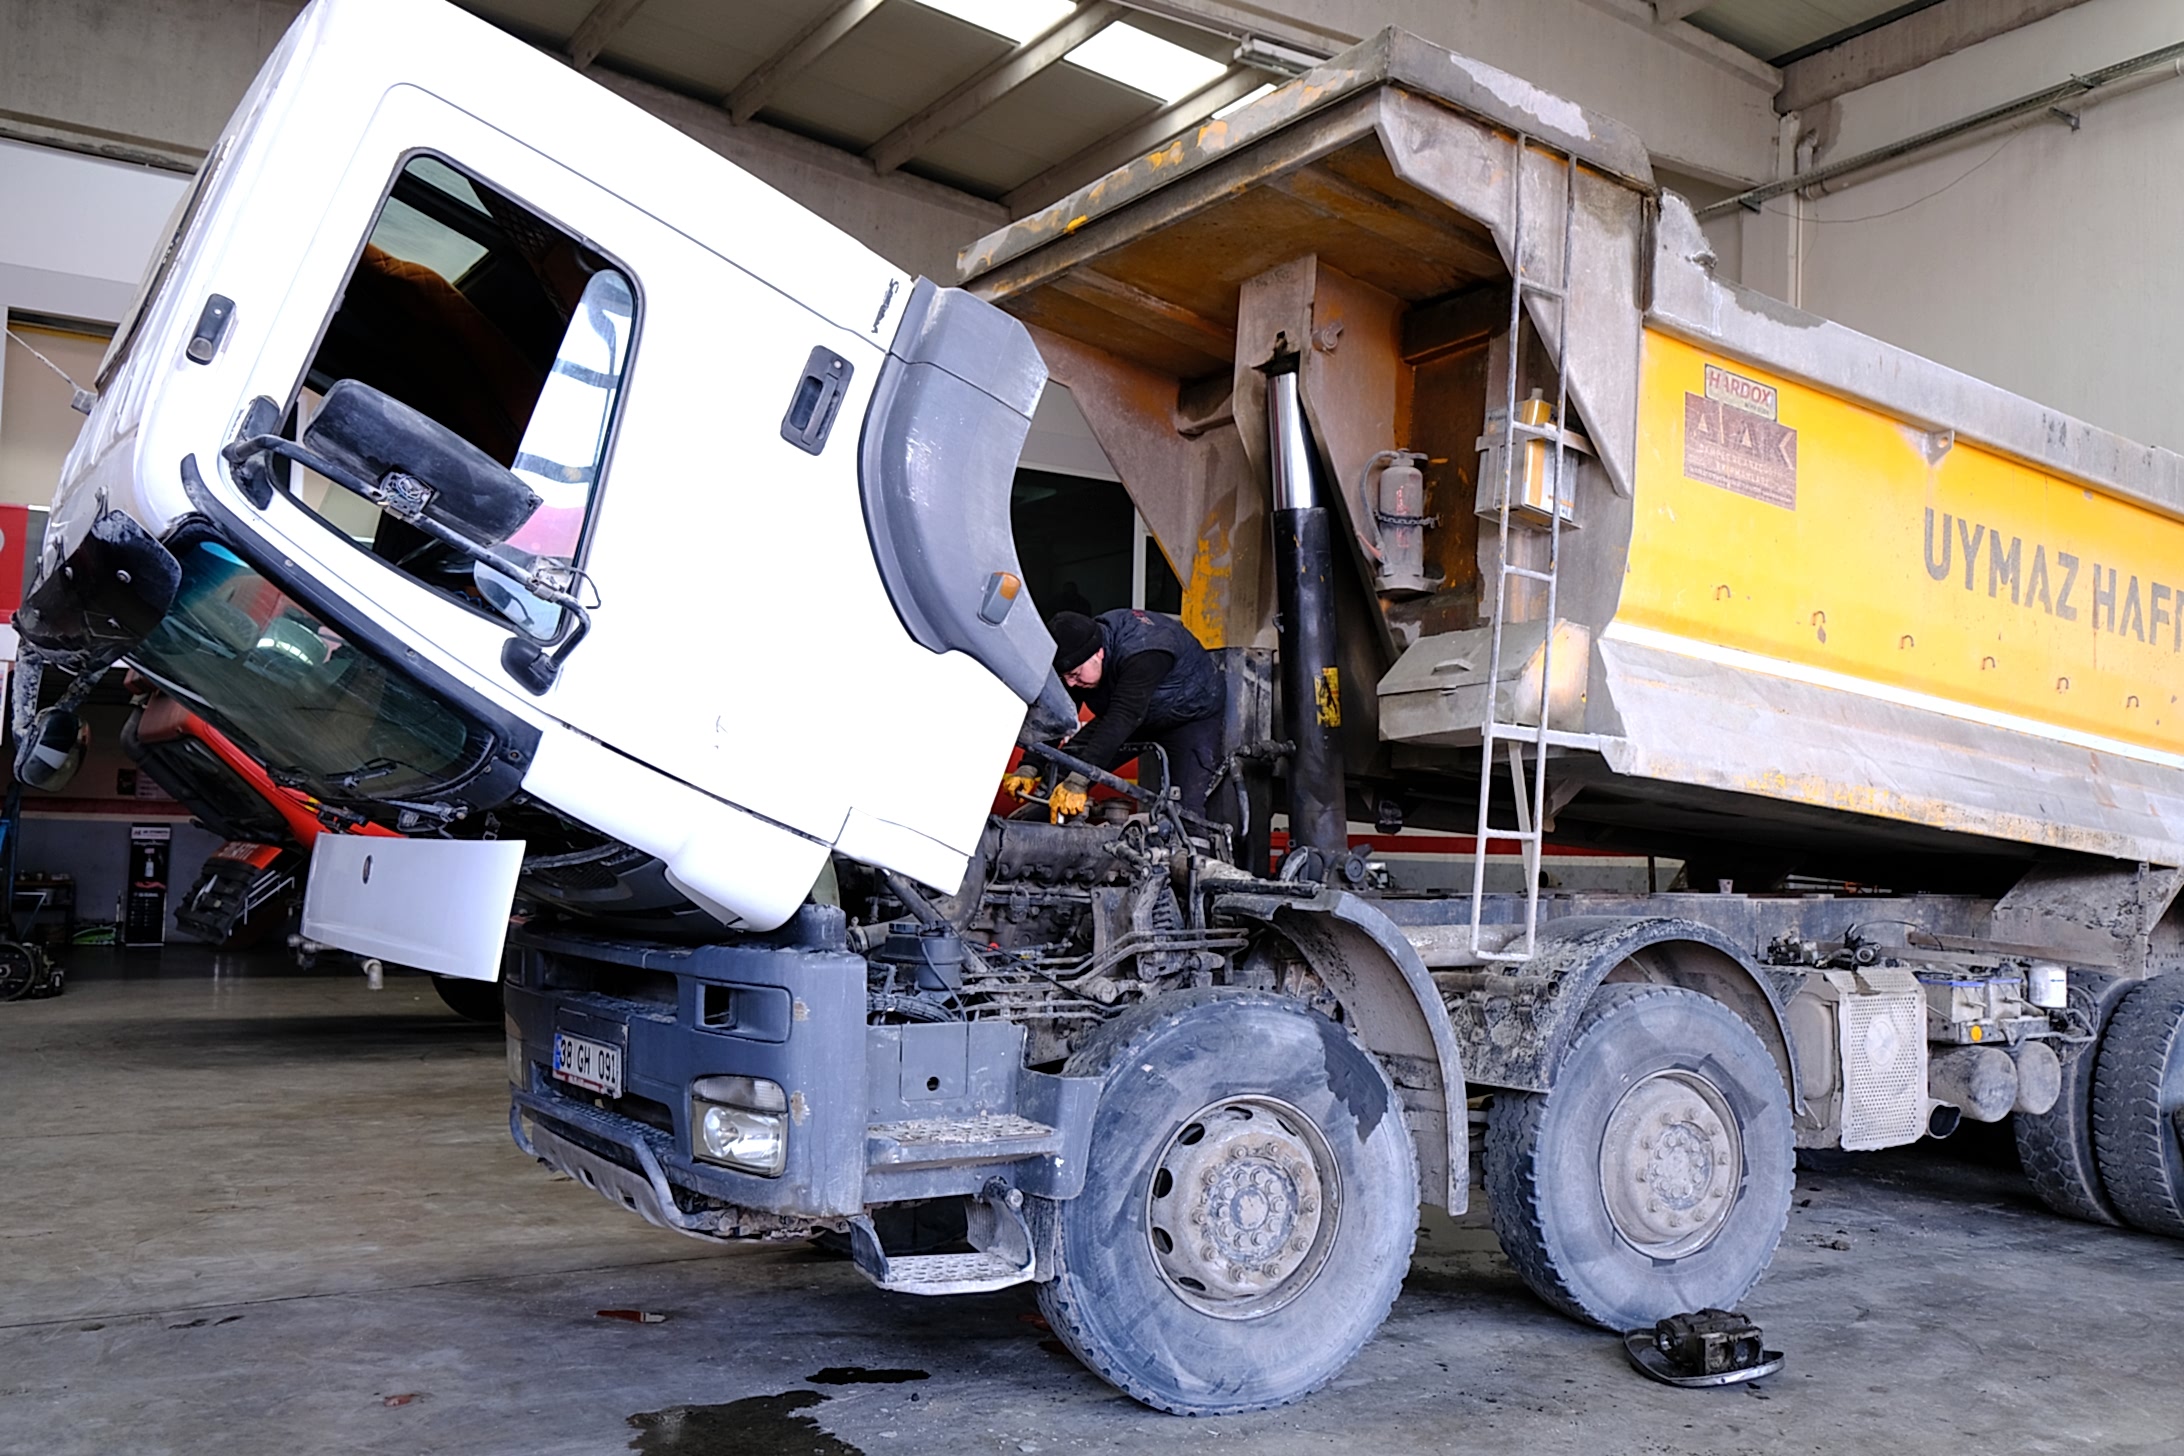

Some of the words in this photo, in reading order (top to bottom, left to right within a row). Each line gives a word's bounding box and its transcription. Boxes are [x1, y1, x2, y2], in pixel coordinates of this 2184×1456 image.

[1709, 370, 1771, 406] HARDOX
[1924, 506, 2080, 622] UYMAZ
[560, 1039, 572, 1069] 38
[578, 1045, 591, 1075] GH
[598, 1050, 615, 1084] 091
